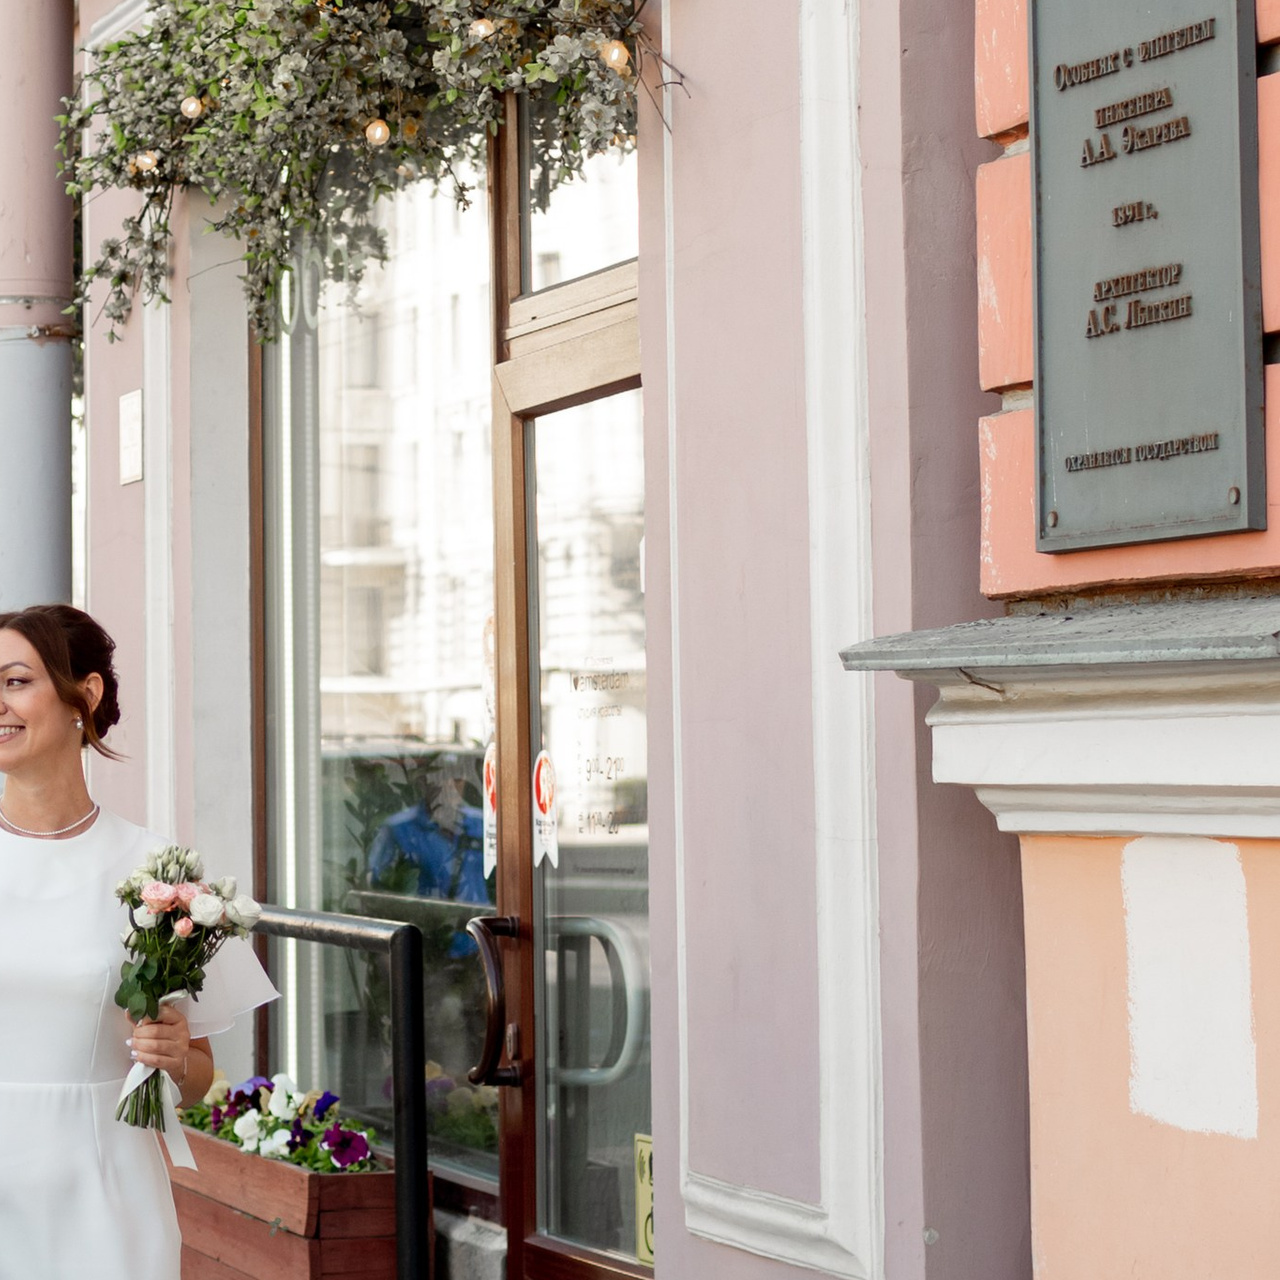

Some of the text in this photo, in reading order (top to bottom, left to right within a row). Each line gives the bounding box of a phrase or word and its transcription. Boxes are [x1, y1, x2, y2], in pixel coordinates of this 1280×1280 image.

[1094, 87, 1173, 129] ИНЖЕНЕРА
[1112, 201, 1143, 227] 1891
[1093, 263, 1183, 302] АРХИТЕКТОР
[1065, 431, 1219, 472] ОХРАНЯЕТСЯ ГОСУДАРСТВОМ
[580, 669, 629, 692] amsterdam
